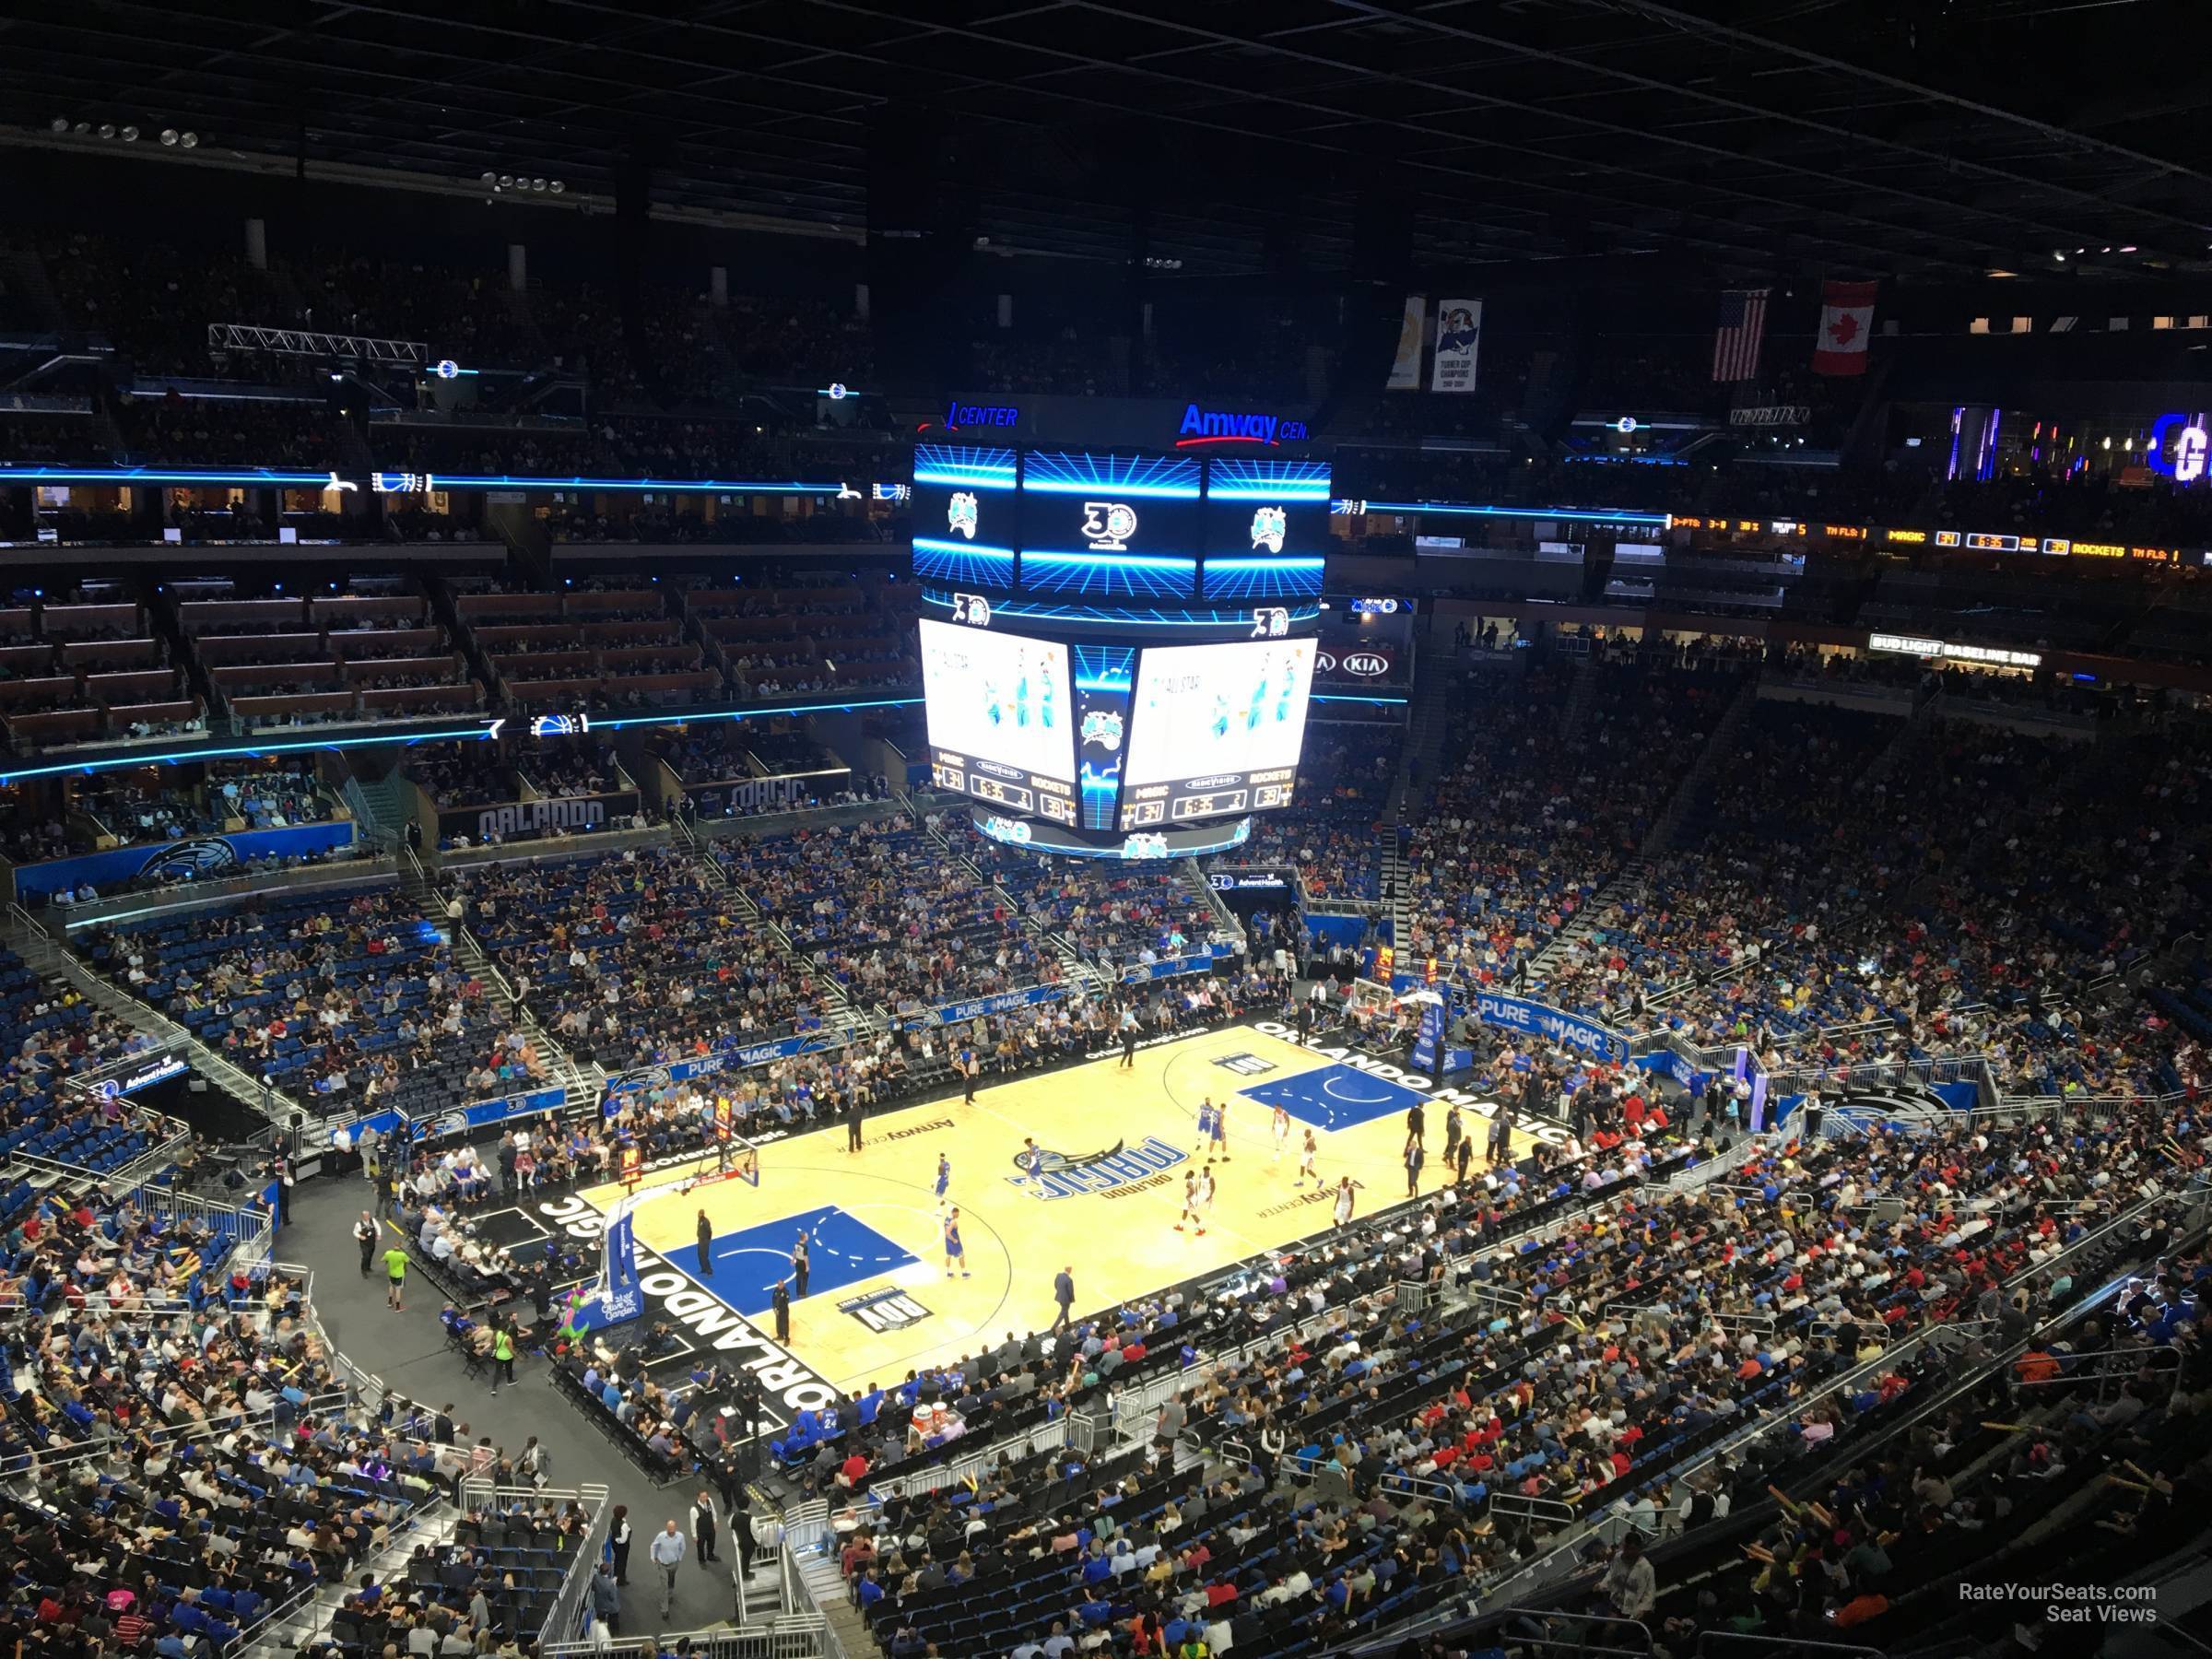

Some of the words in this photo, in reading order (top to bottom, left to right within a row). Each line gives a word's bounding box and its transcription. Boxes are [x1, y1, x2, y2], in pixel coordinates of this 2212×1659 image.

[959, 406, 1018, 426] CENTER
[1180, 404, 1277, 444] Amway
[1280, 421, 1310, 440] CEN
[1889, 530, 1926, 542] MAGIC
[1940, 534, 1955, 544] 34
[1978, 536, 2002, 547] 6:35
[2051, 541, 2066, 552] 39
[2073, 544, 2124, 557] ROCKETS
[1872, 636, 1900, 649] BUD
[1901, 639, 1941, 654] LIGHT
[1944, 644, 2010, 662] BASELINE
[2011, 652, 2041, 665] BAR
[1350, 657, 1381, 671] KIA
[948, 772, 961, 787] 34
[732, 778, 806, 807] MAGIC
[980, 781, 1004, 799] 6:35
[1144, 805, 1159, 820] 34
[1184, 797, 1213, 814] 6:35
[478, 800, 604, 835] ORLANDO
[956, 1003, 984, 1018] PURE
[996, 994, 1030, 1009] MAGIC
[1481, 999, 1530, 1025] PURE
[1550, 1018, 1603, 1052] MAGIC
[739, 1045, 782, 1064] MAGIC
[887, 1119, 955, 1141] Amway
[1100, 1174, 1172, 1199] ORLANDO
[1300, 1180, 1365, 1205] Away
[1256, 1198, 1304, 1218] CENTER
[605, 1306, 638, 1323] Garden
[640, 1273, 837, 1411] ORLANDO
[824, 1418, 837, 1430] 24
